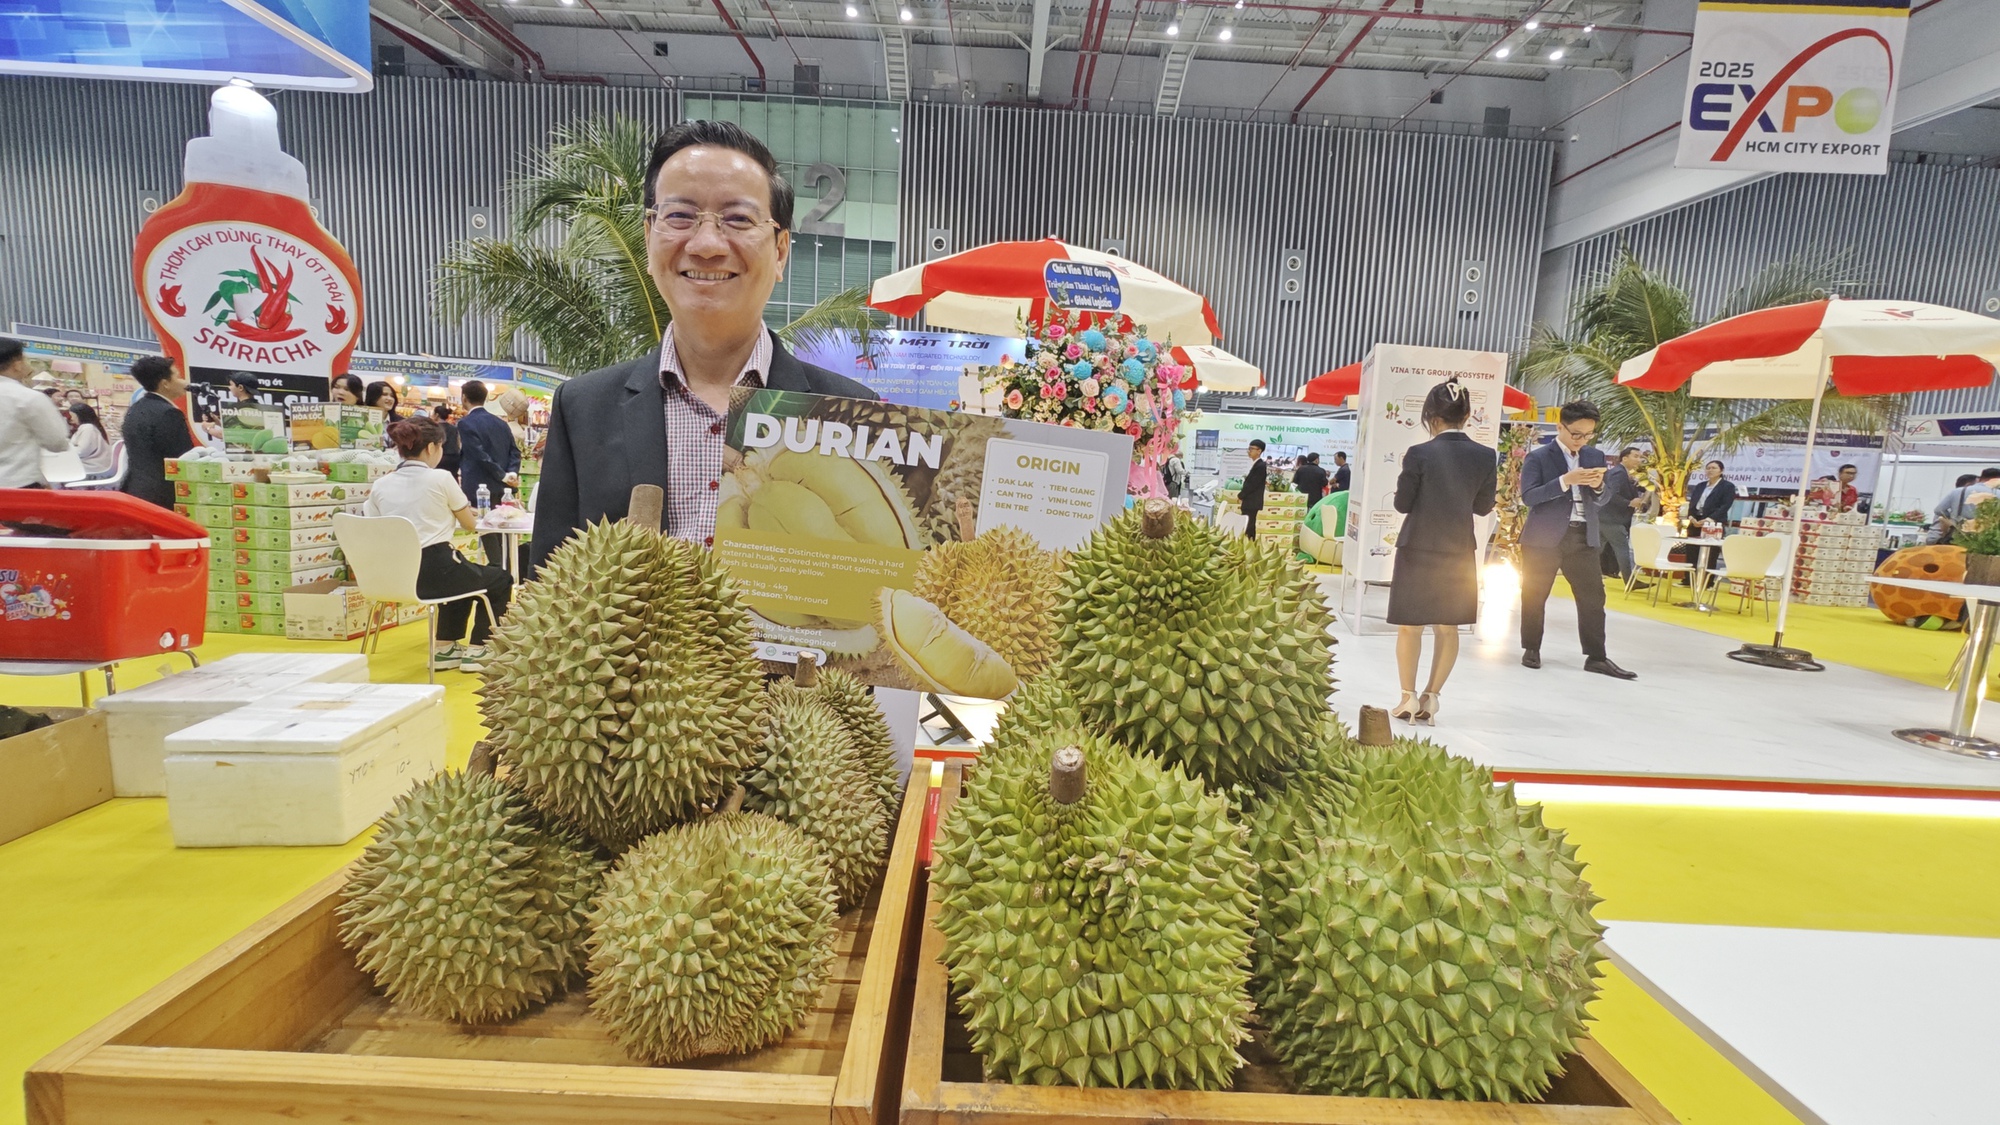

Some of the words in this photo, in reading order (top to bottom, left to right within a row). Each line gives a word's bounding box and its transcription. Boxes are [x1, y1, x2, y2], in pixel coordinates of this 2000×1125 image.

[1699, 61, 1754, 78] 2025
[1689, 82, 1883, 135] EXPO
[1745, 141, 1780, 153] HCM
[1784, 142, 1817, 154] CITY
[1821, 143, 1881, 156] EXPORT
[801, 162, 846, 238] 2
[159, 246, 188, 281] THƠM
[186, 233, 214, 253] CAY
[215, 228, 262, 245] DÙNG
[266, 235, 307, 260] THAY
[321, 274, 346, 302] TRÁI
[1094, 268, 1112, 281] Group
[1074, 294, 1092, 306] Global
[1092, 297, 1113, 310] Logistics
[193, 327, 322, 365] SRIRACHA
[899, 336, 941, 349] MẶT
[948, 337, 991, 350] TRỜI
[908, 352, 942, 360] INTEGRATED
[942, 353, 981, 361] TECHNOLOGY
[1390, 366, 1409, 374] VINA
[1411, 367, 1426, 375] T&T
[1427, 369, 1452, 377] GROUP
[1455, 371, 1495, 380] ECOSYSTEM
[1234, 422, 1254, 431] CÔNG
[1286, 426, 1330, 434] HEROPOWER
[743, 412, 944, 470] DURIAN
[1016, 455, 1081, 476] ORIGIN
[998, 477, 1016, 486] DAK
[1018, 480, 1034, 488] LAK
[1723, 474, 1752, 482] NHANH
[1759, 475, 1772, 483] AN
[1775, 473, 1800, 484] TOÀN
[996, 489, 1015, 498] CAN
[1016, 492, 1033, 500] THO
[1049, 484, 1068, 493] TIEN
[1069, 486, 1096, 496] GIANG
[995, 501, 1012, 510] BEN
[1014, 504, 1029, 512] TRE
[1047, 496, 1068, 505] VINH
[1069, 499, 1092, 508] LONG
[1046, 508, 1070, 518] DONG
[1072, 511, 1094, 520] THAP
[722, 539, 787, 554] Characteristics:
[788, 547, 830, 560] Distinctive
[831, 554, 858, 563] aroma
[860, 557, 877, 566] with
[885, 560, 904, 569] hard
[720, 557, 740, 567] flesh
[749, 562, 778, 573] usually
[779, 565, 797, 575] pale
[797, 567, 825, 577] yellow.
[721, 549, 755, 559] external
[755, 553, 777, 563] husk,
[778, 556, 811, 566] covered
[812, 560, 830, 568] with
[831, 563, 853, 571] stout
[854, 566, 881, 575] spines.
[883, 569, 898, 577] The
[753, 580, 766, 588] 1kg
[772, 582, 789, 592] 4kg
[751, 589, 783, 599] Season:
[784, 594, 829, 605] Year-round
[765, 623, 776, 631] by
[777, 625, 794, 633] U.S.
[795, 627, 822, 636] Export
[789, 635, 837, 647] Recognized
